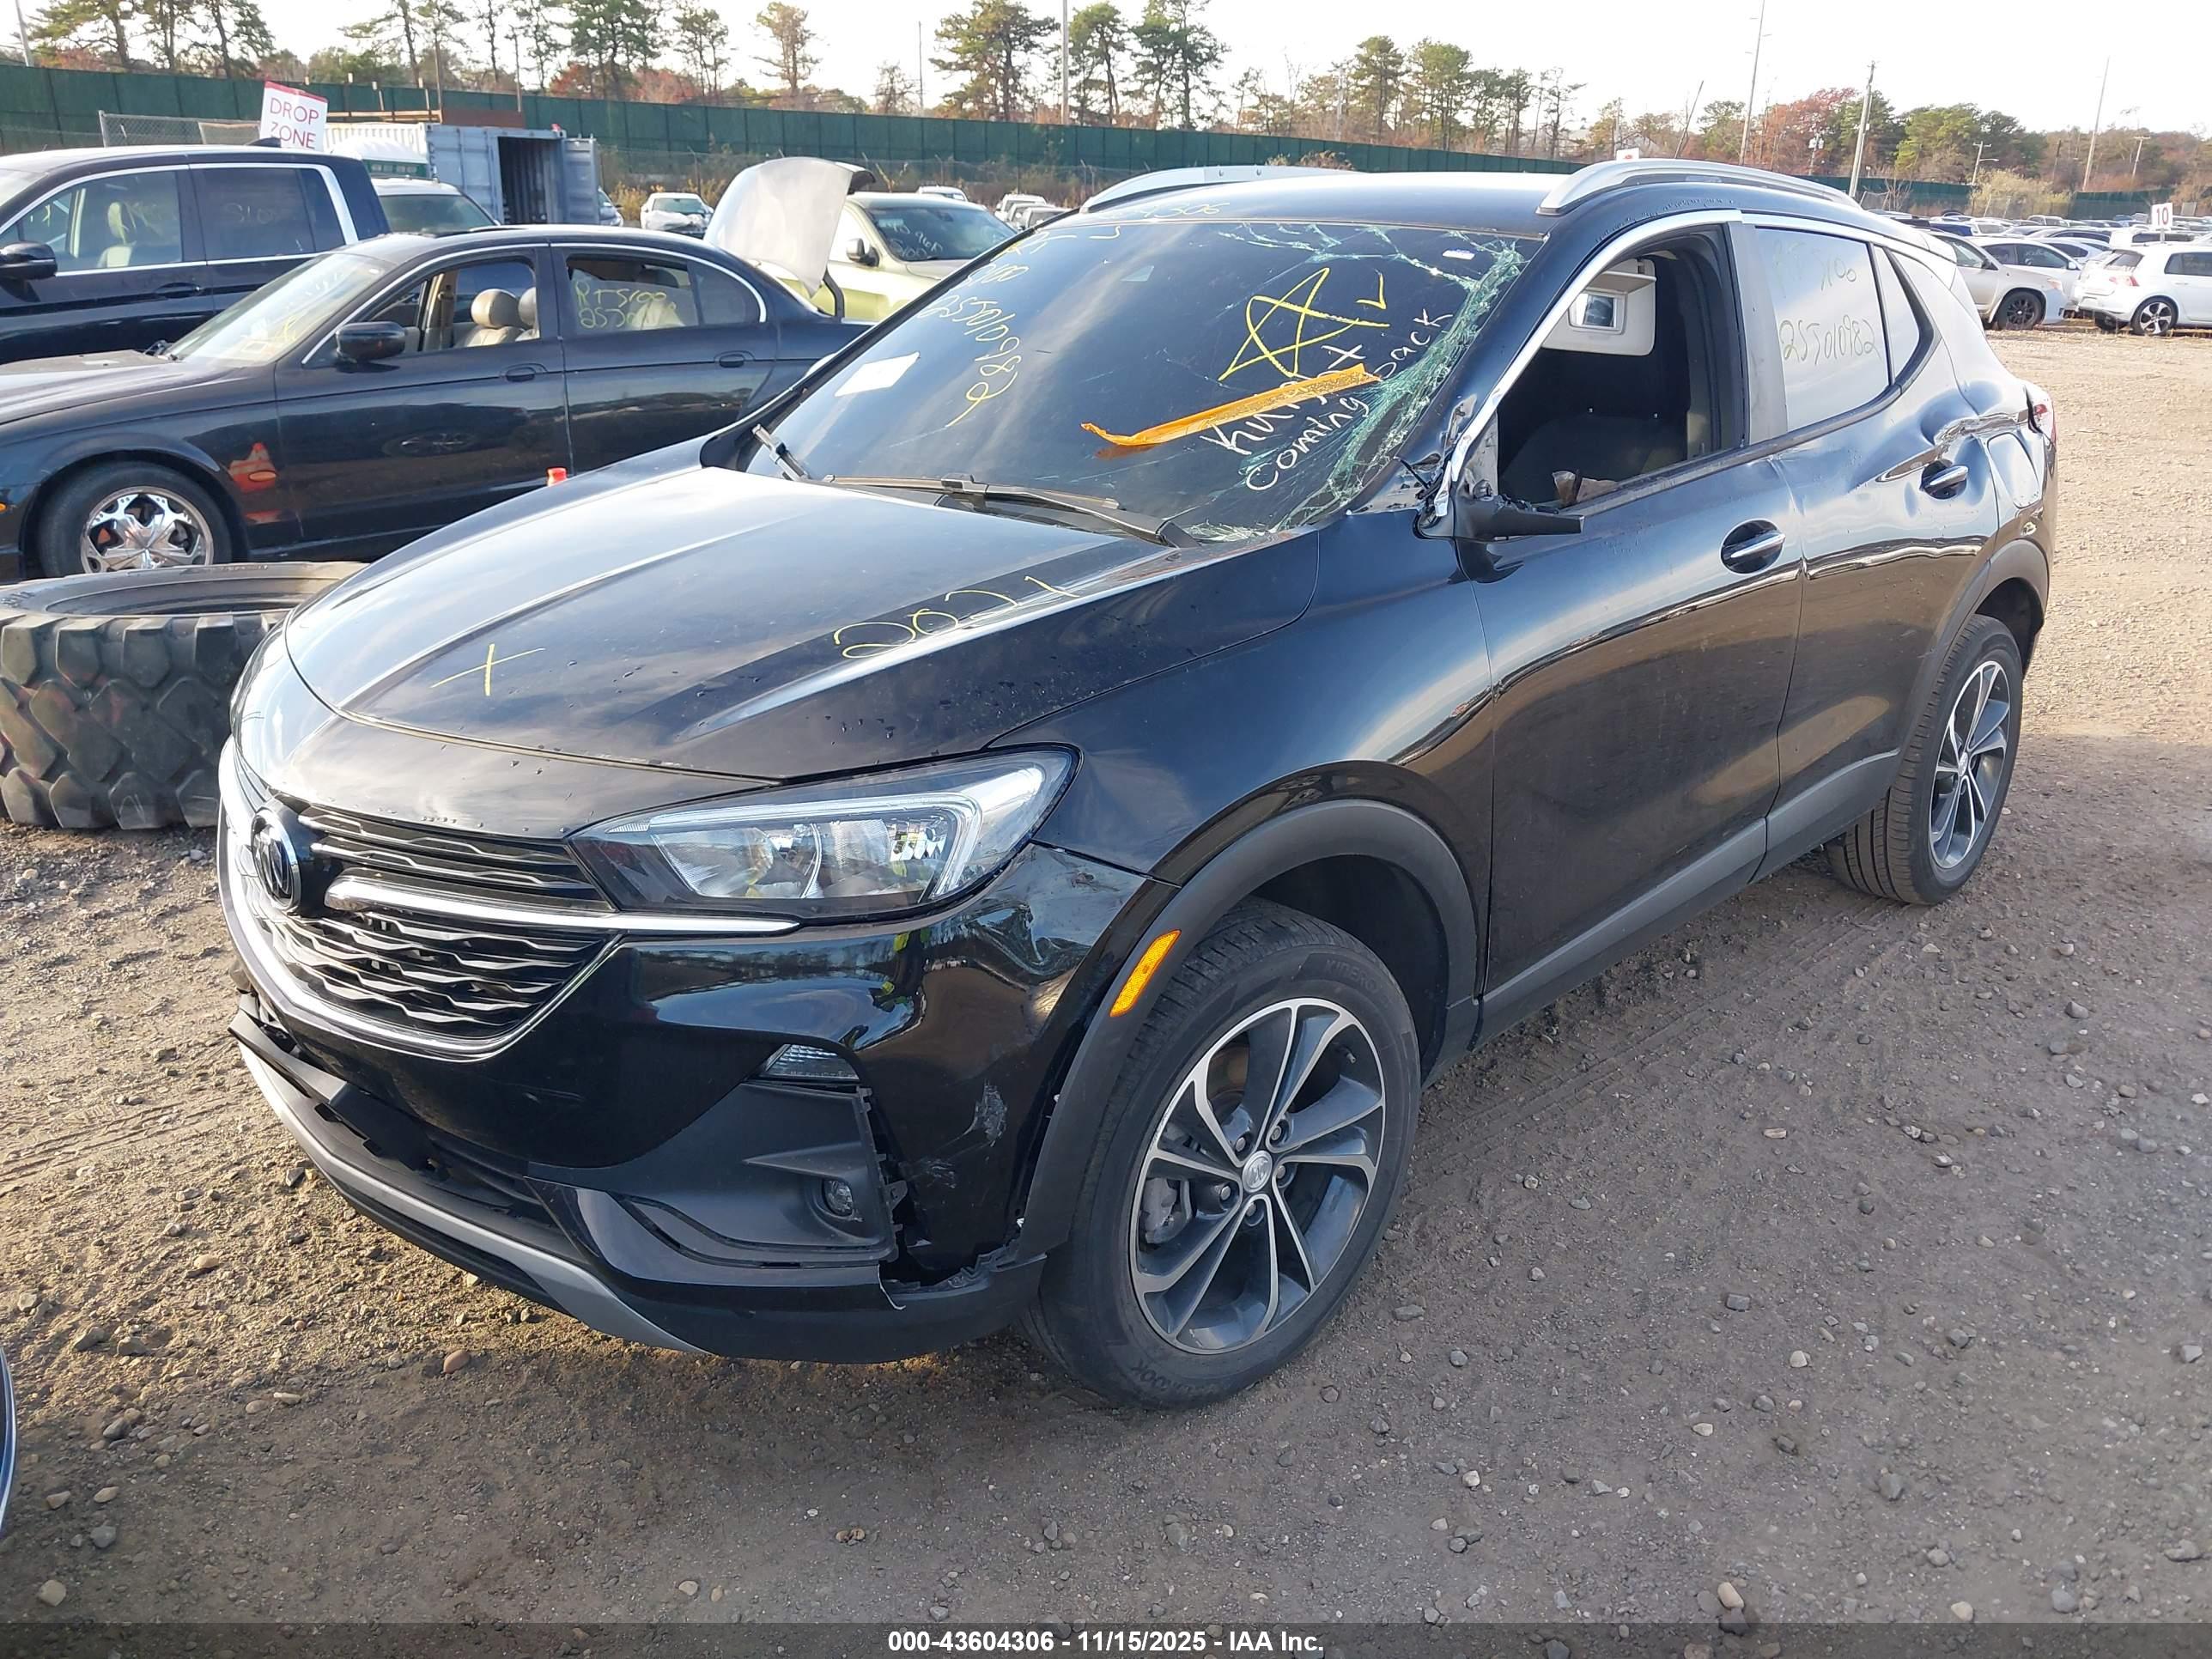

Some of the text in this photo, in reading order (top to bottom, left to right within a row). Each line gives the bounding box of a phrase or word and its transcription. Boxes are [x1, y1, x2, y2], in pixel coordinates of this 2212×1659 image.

[270, 97, 319, 125] DROP
[270, 121, 316, 149] ZONE
[2156, 206, 2169, 226] 10
